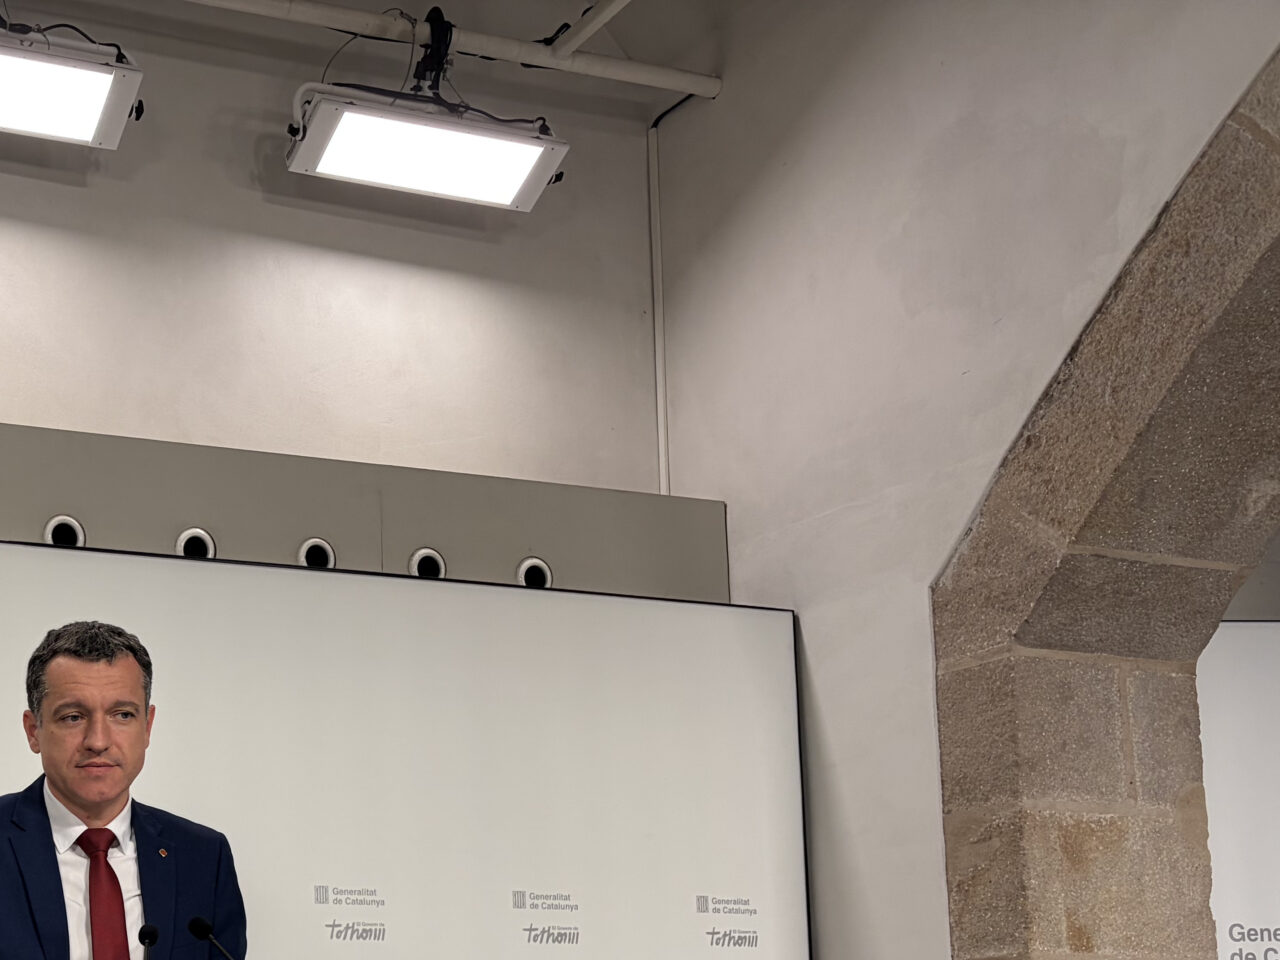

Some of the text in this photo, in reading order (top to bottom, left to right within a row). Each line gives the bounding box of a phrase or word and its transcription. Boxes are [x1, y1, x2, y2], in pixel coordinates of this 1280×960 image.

[332, 887, 377, 897] Generalitat
[529, 892, 571, 901] Generalitat
[332, 897, 385, 908] de Catalunya
[712, 897, 750, 906] Generalitat
[529, 902, 579, 912] de Catalunya
[712, 906, 757, 916] de Catalunya
